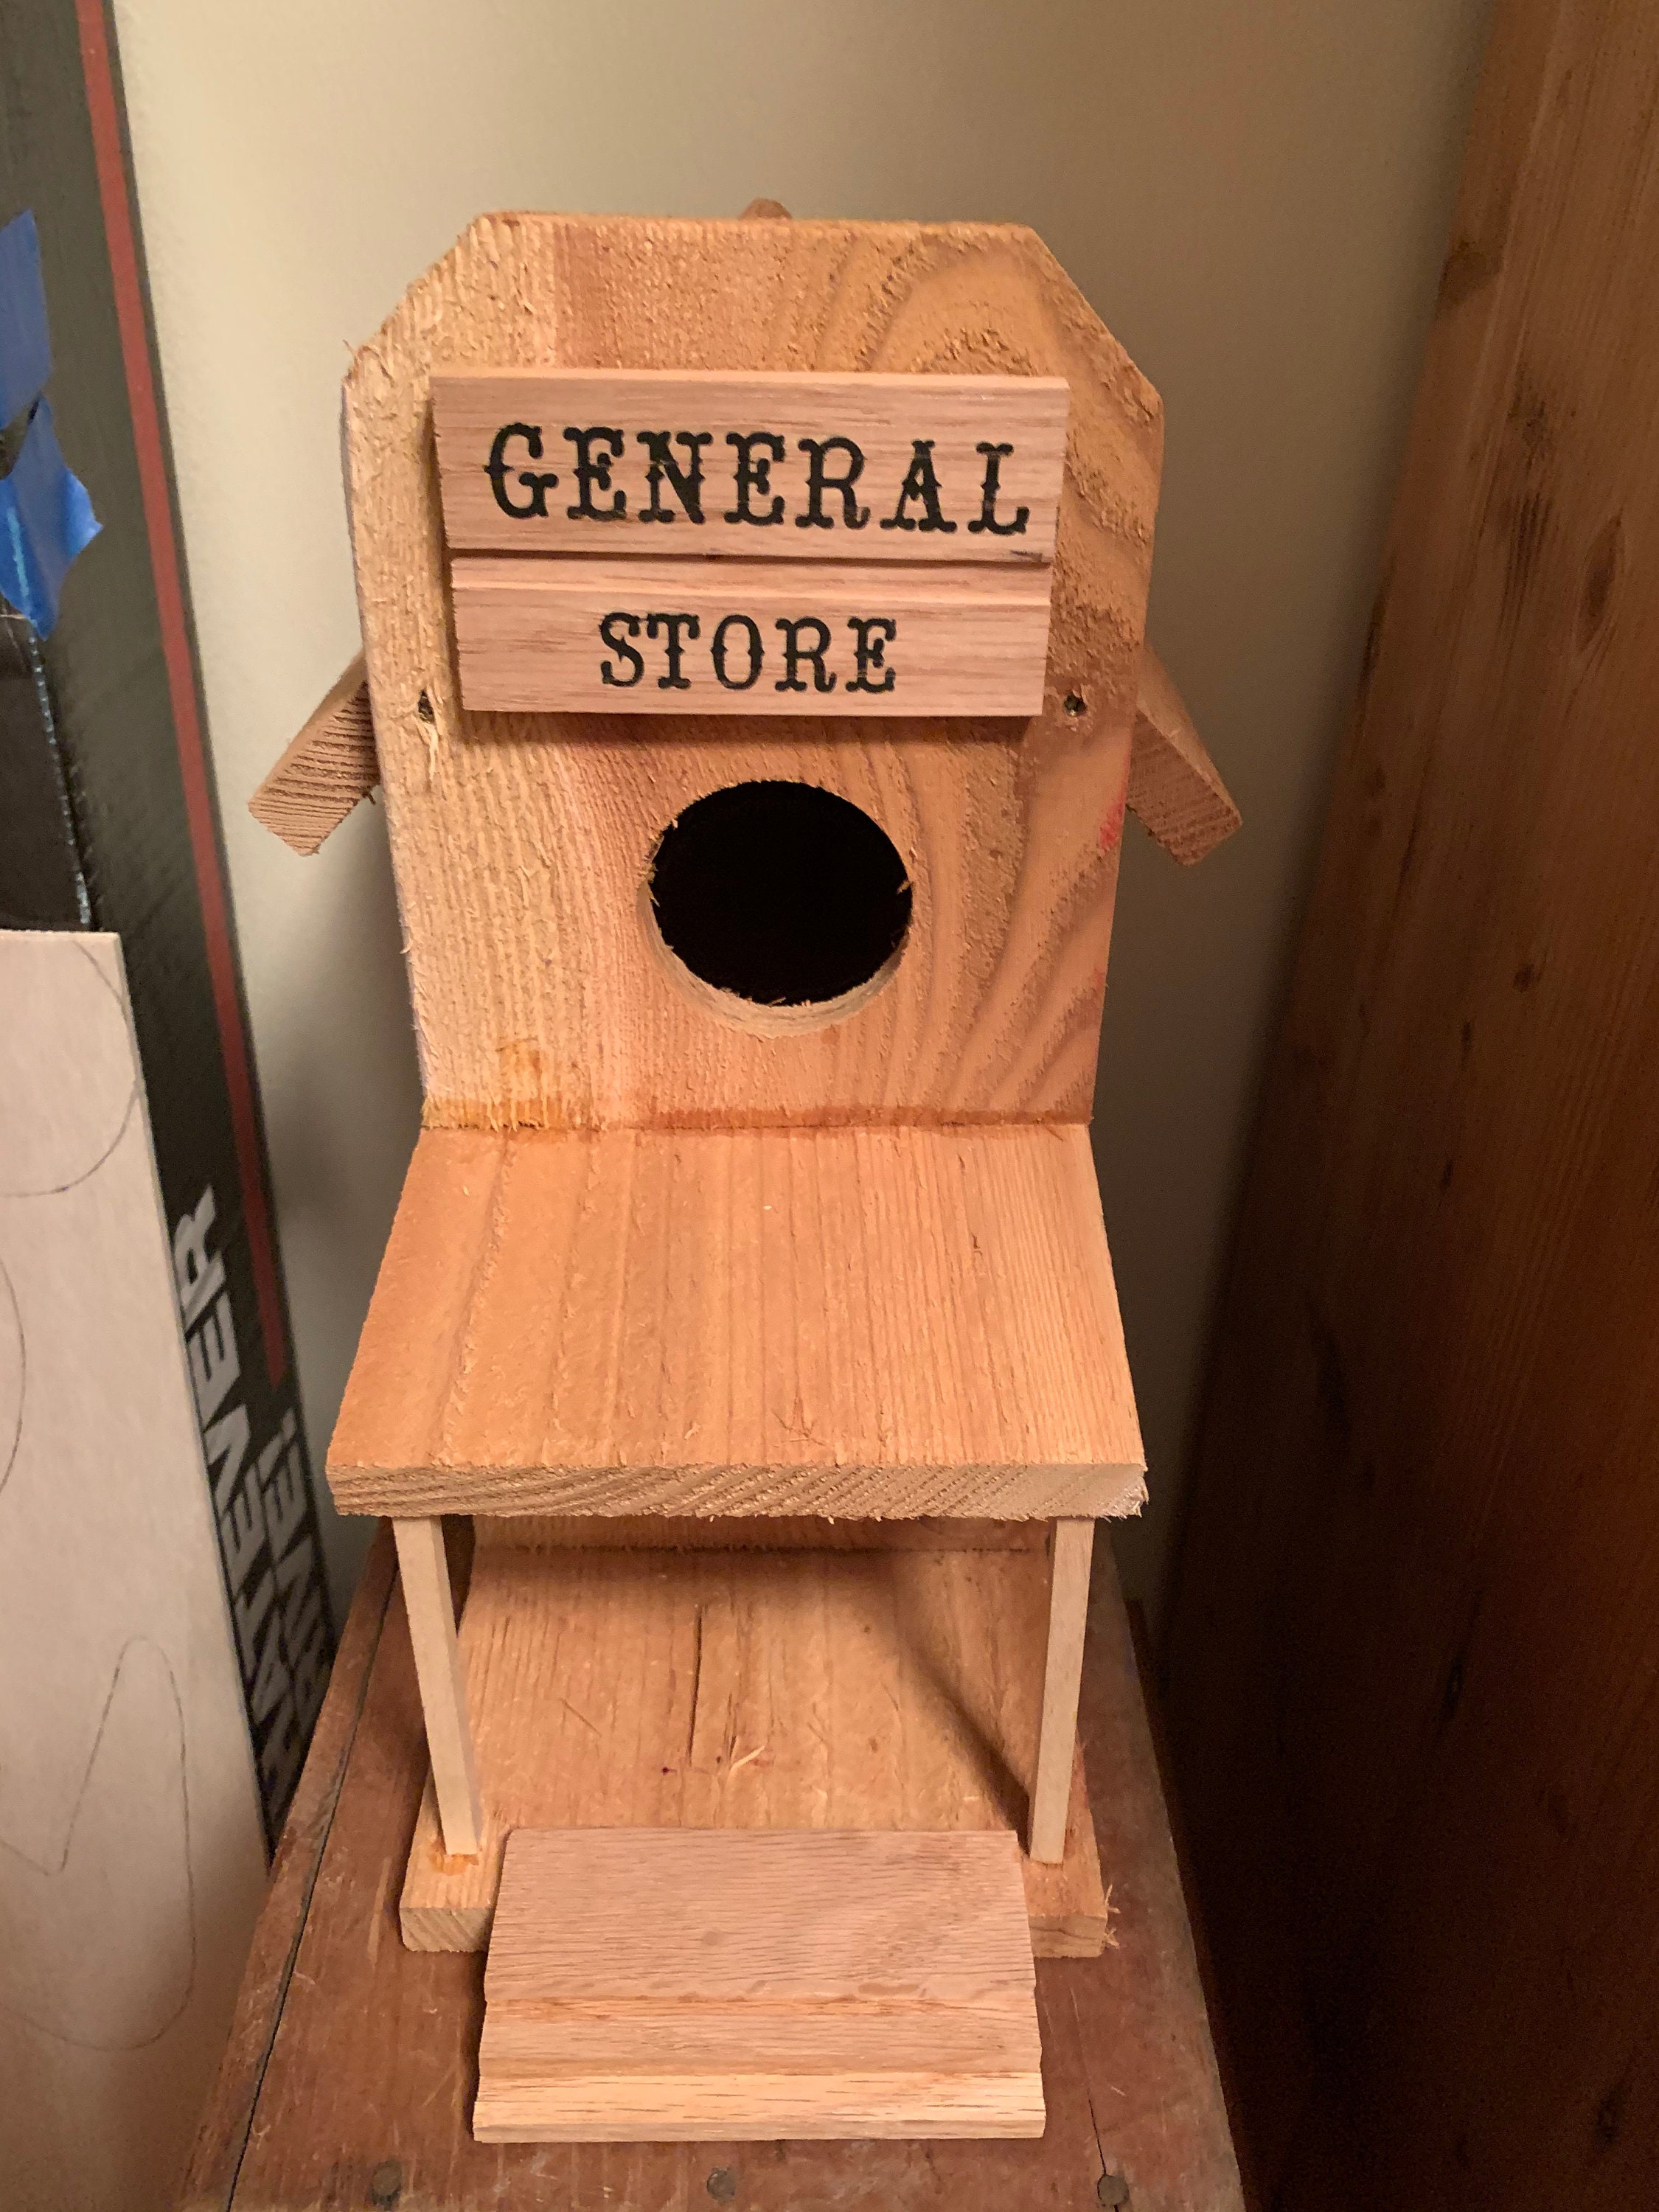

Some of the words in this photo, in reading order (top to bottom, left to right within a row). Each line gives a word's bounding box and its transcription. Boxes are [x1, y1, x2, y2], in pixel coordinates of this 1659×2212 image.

[484, 422, 1030, 536] GENERAL
[599, 611, 897, 694] STORE
[174, 1183, 299, 1843] HATEVER
[258, 1406, 331, 1737] RIVE!
